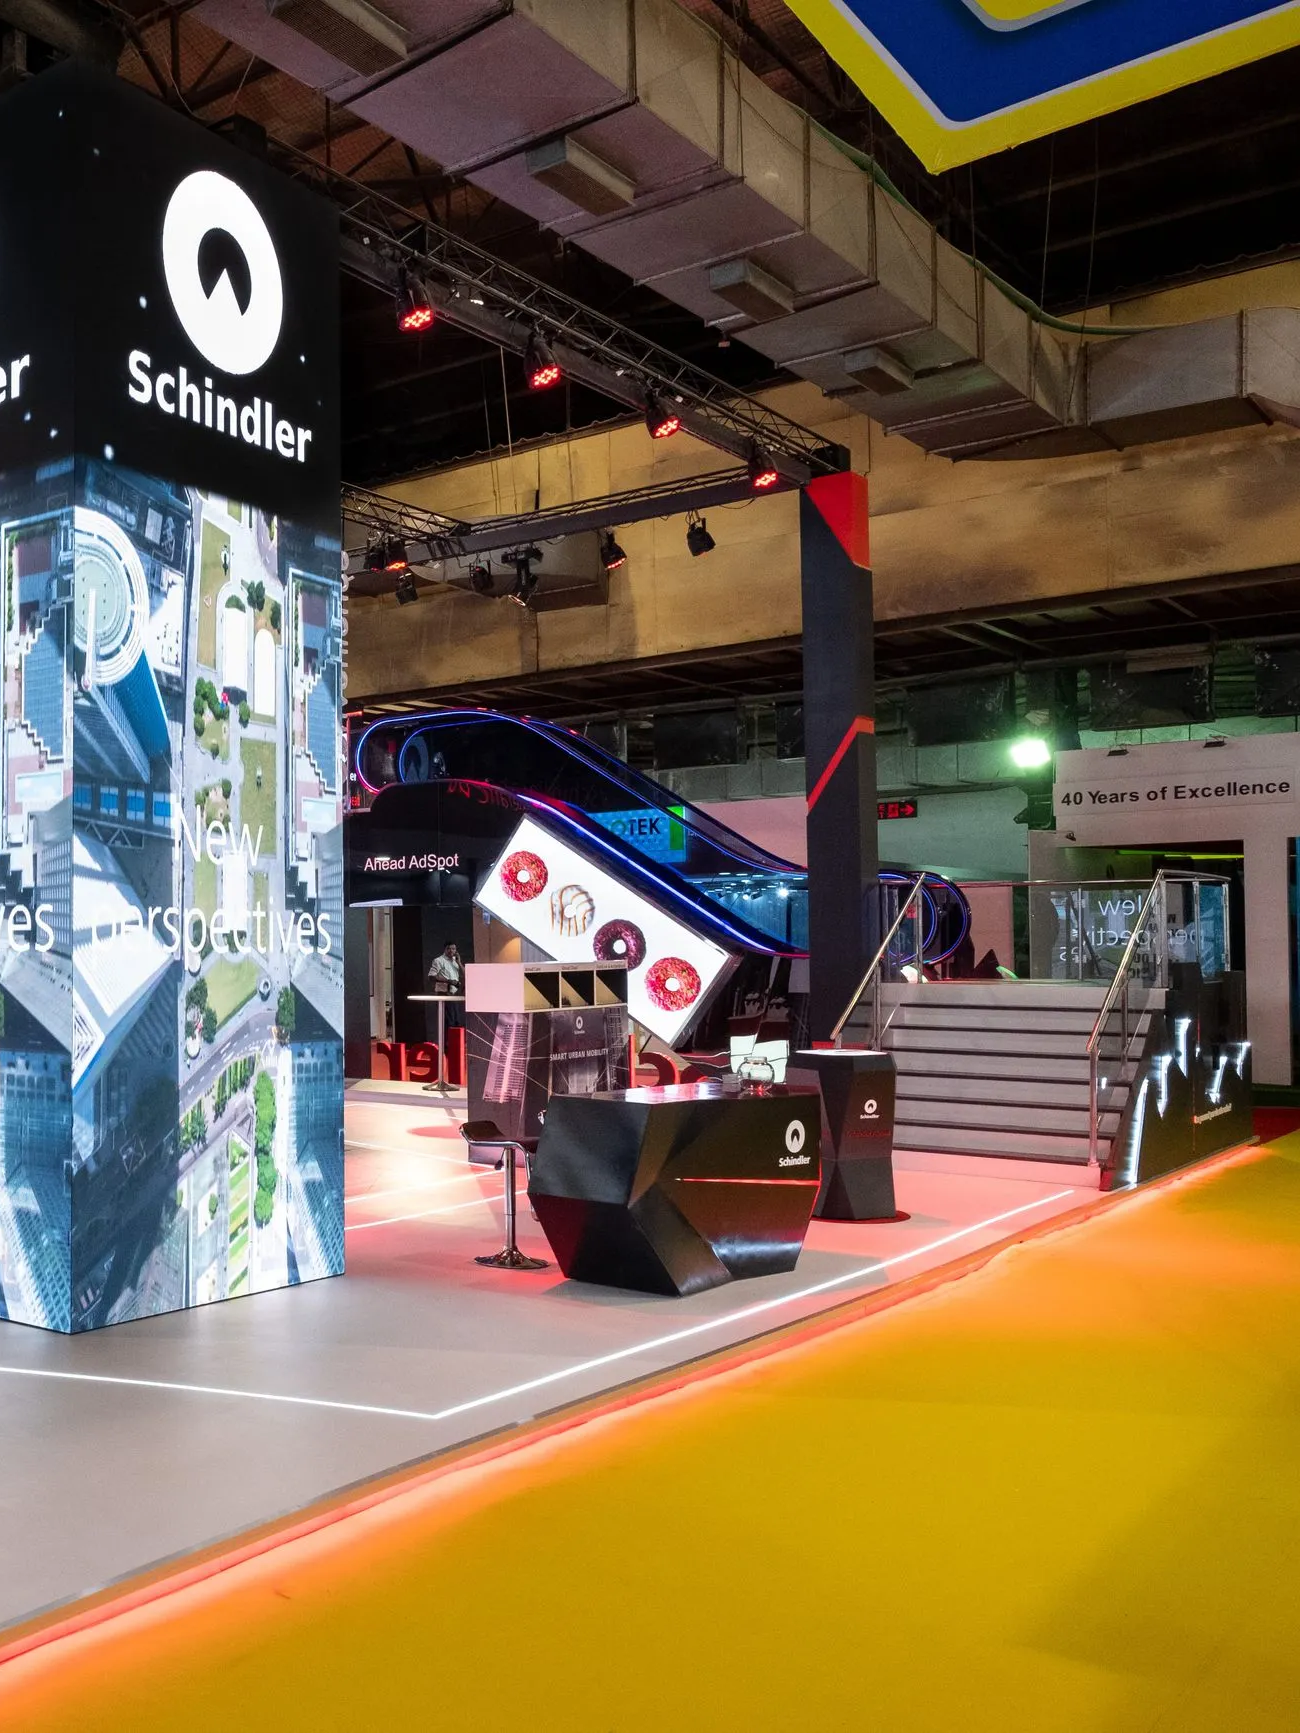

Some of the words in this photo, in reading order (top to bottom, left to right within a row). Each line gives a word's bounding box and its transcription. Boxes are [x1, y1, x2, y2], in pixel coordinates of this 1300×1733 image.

[127, 349, 313, 463] Schindler
[1061, 791, 1083, 806] 40
[1088, 790, 1140, 804] Years
[1147, 786, 1168, 801] of
[1174, 781, 1291, 800] Excellence
[174, 803, 264, 868] New
[364, 856, 406, 872] Ahead
[408, 853, 460, 871] AdSpot
[91, 894, 333, 963] perspectives
[778, 1154, 812, 1168] Schindler
